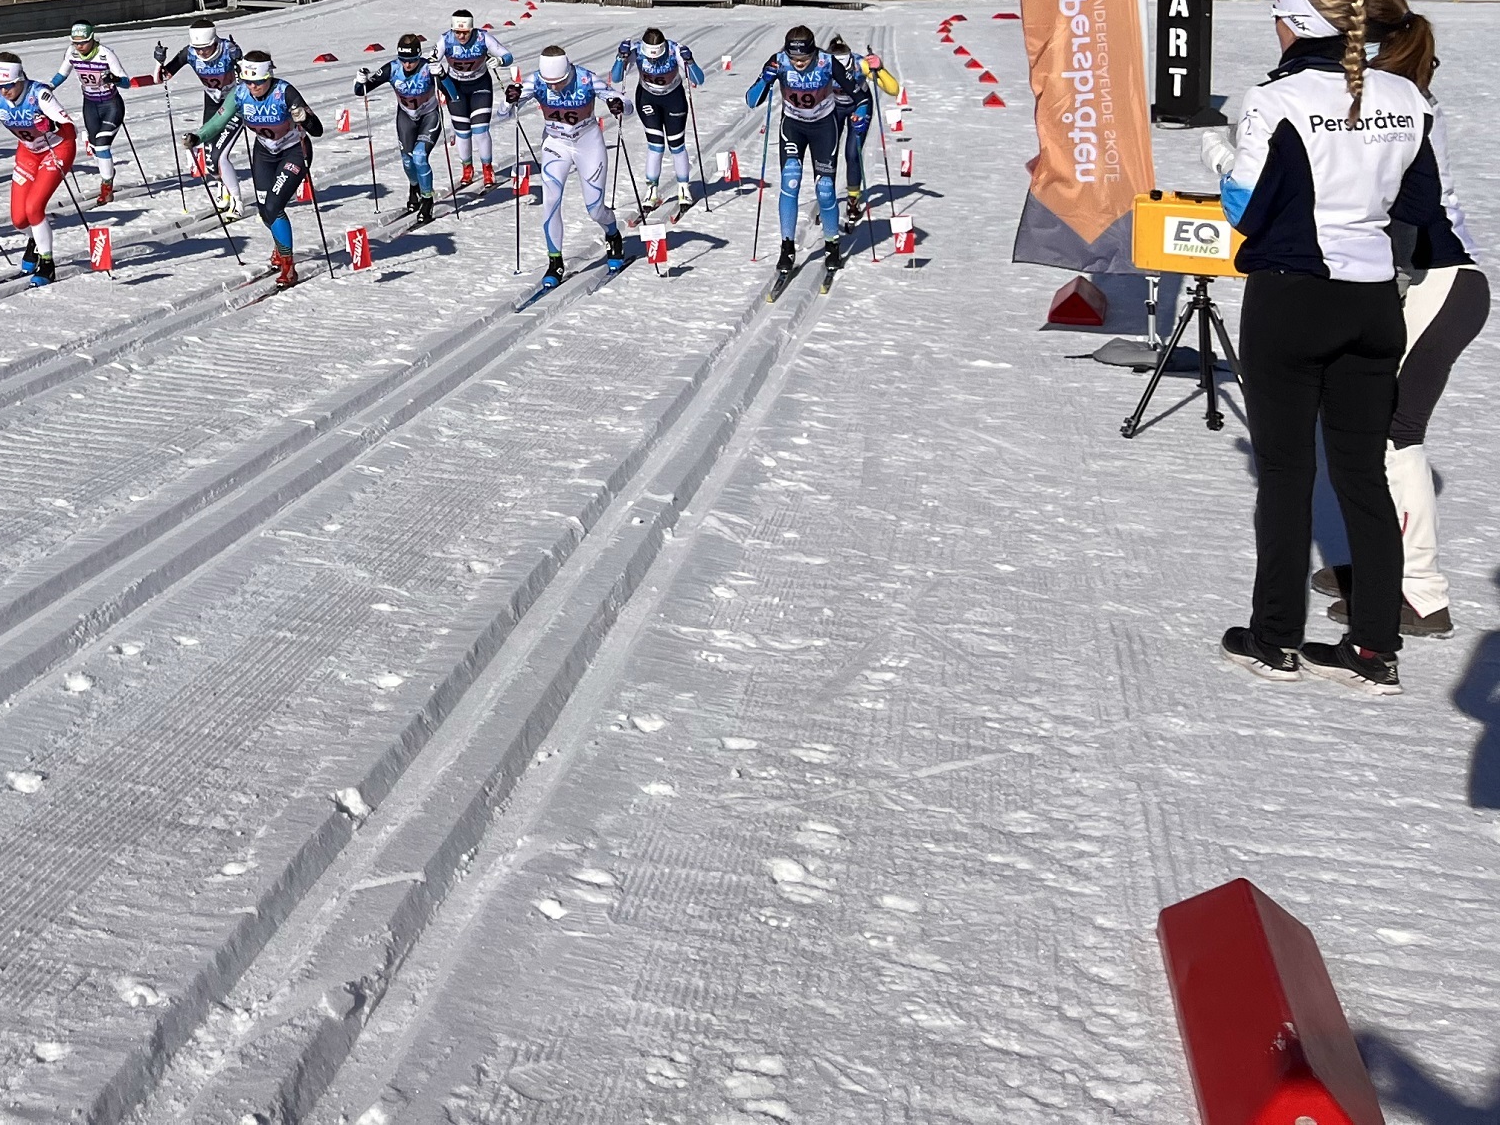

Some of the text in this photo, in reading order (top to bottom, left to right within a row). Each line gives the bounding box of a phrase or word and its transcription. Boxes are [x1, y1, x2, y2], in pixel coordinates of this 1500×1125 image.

[453, 61, 476, 72] 57
[80, 73, 97, 84] 59
[799, 70, 822, 83] VVS
[562, 88, 586, 100] VVS
[788, 93, 816, 110] 49
[11, 108, 33, 121] VVS
[255, 103, 278, 116] VVS
[547, 110, 579, 126] 46
[1363, 131, 1416, 145] LANGRENN
[1173, 220, 1220, 245] EQ
[1173, 243, 1220, 255] TIMING
